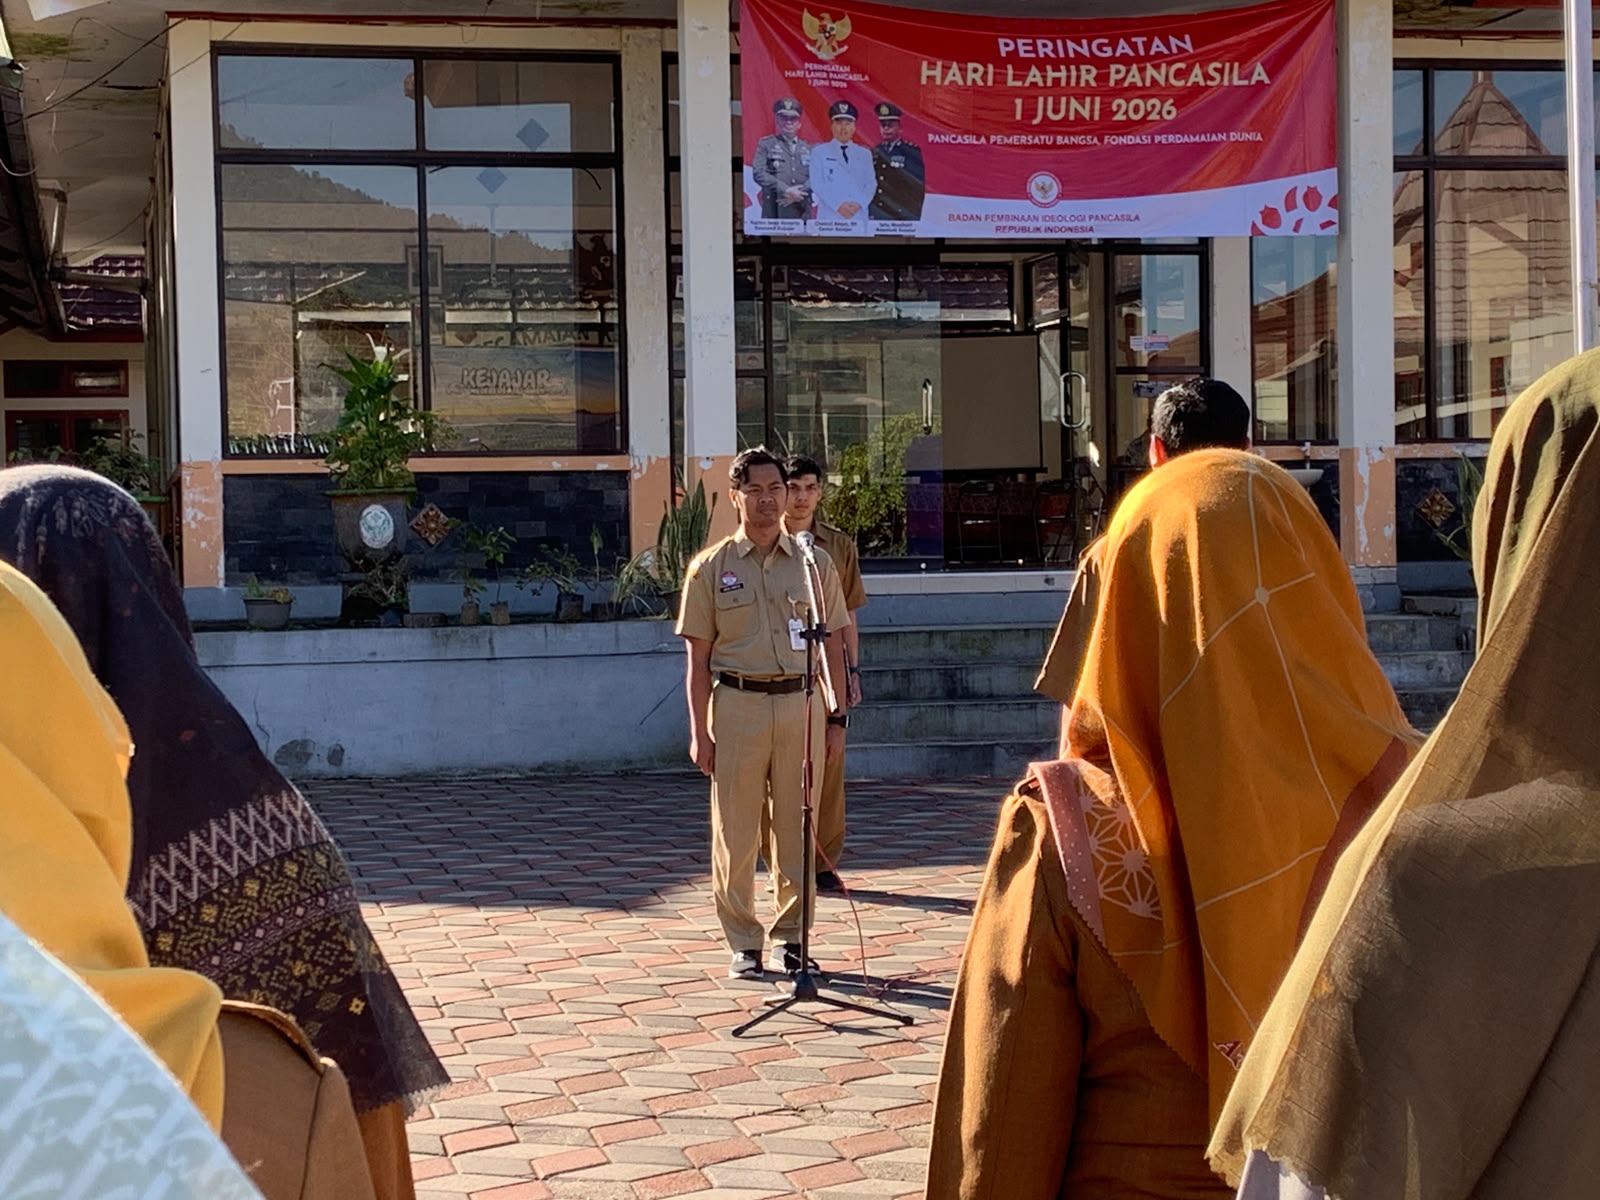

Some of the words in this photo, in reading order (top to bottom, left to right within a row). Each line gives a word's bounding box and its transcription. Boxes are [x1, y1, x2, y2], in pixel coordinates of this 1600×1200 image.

[997, 33, 1194, 58] PERINGATAN
[920, 61, 994, 86] HARI
[1006, 64, 1097, 87] LAHIR
[1109, 62, 1271, 87] PANCASILA
[1013, 99, 1022, 121] 1
[1031, 96, 1101, 125] JUNI
[1111, 98, 1178, 121] 2026
[928, 133, 987, 145] PANCASILA
[989, 135, 1053, 145] PEMERSATU
[1104, 135, 1151, 145] FONDASI
[1154, 132, 1227, 144] PERDAMAIAN
[1229, 132, 1263, 142] DUNIA
[948, 213, 981, 222] BADAN
[984, 214, 1040, 223] PEMBINAAN
[1041, 214, 1087, 223] IDEOLOGI
[1088, 213, 1140, 222] PANCASILA
[995, 225, 1041, 233] REPUBLIK
[1044, 225, 1094, 233] INDONESIA
[462, 366, 551, 390] KEJAJAR
